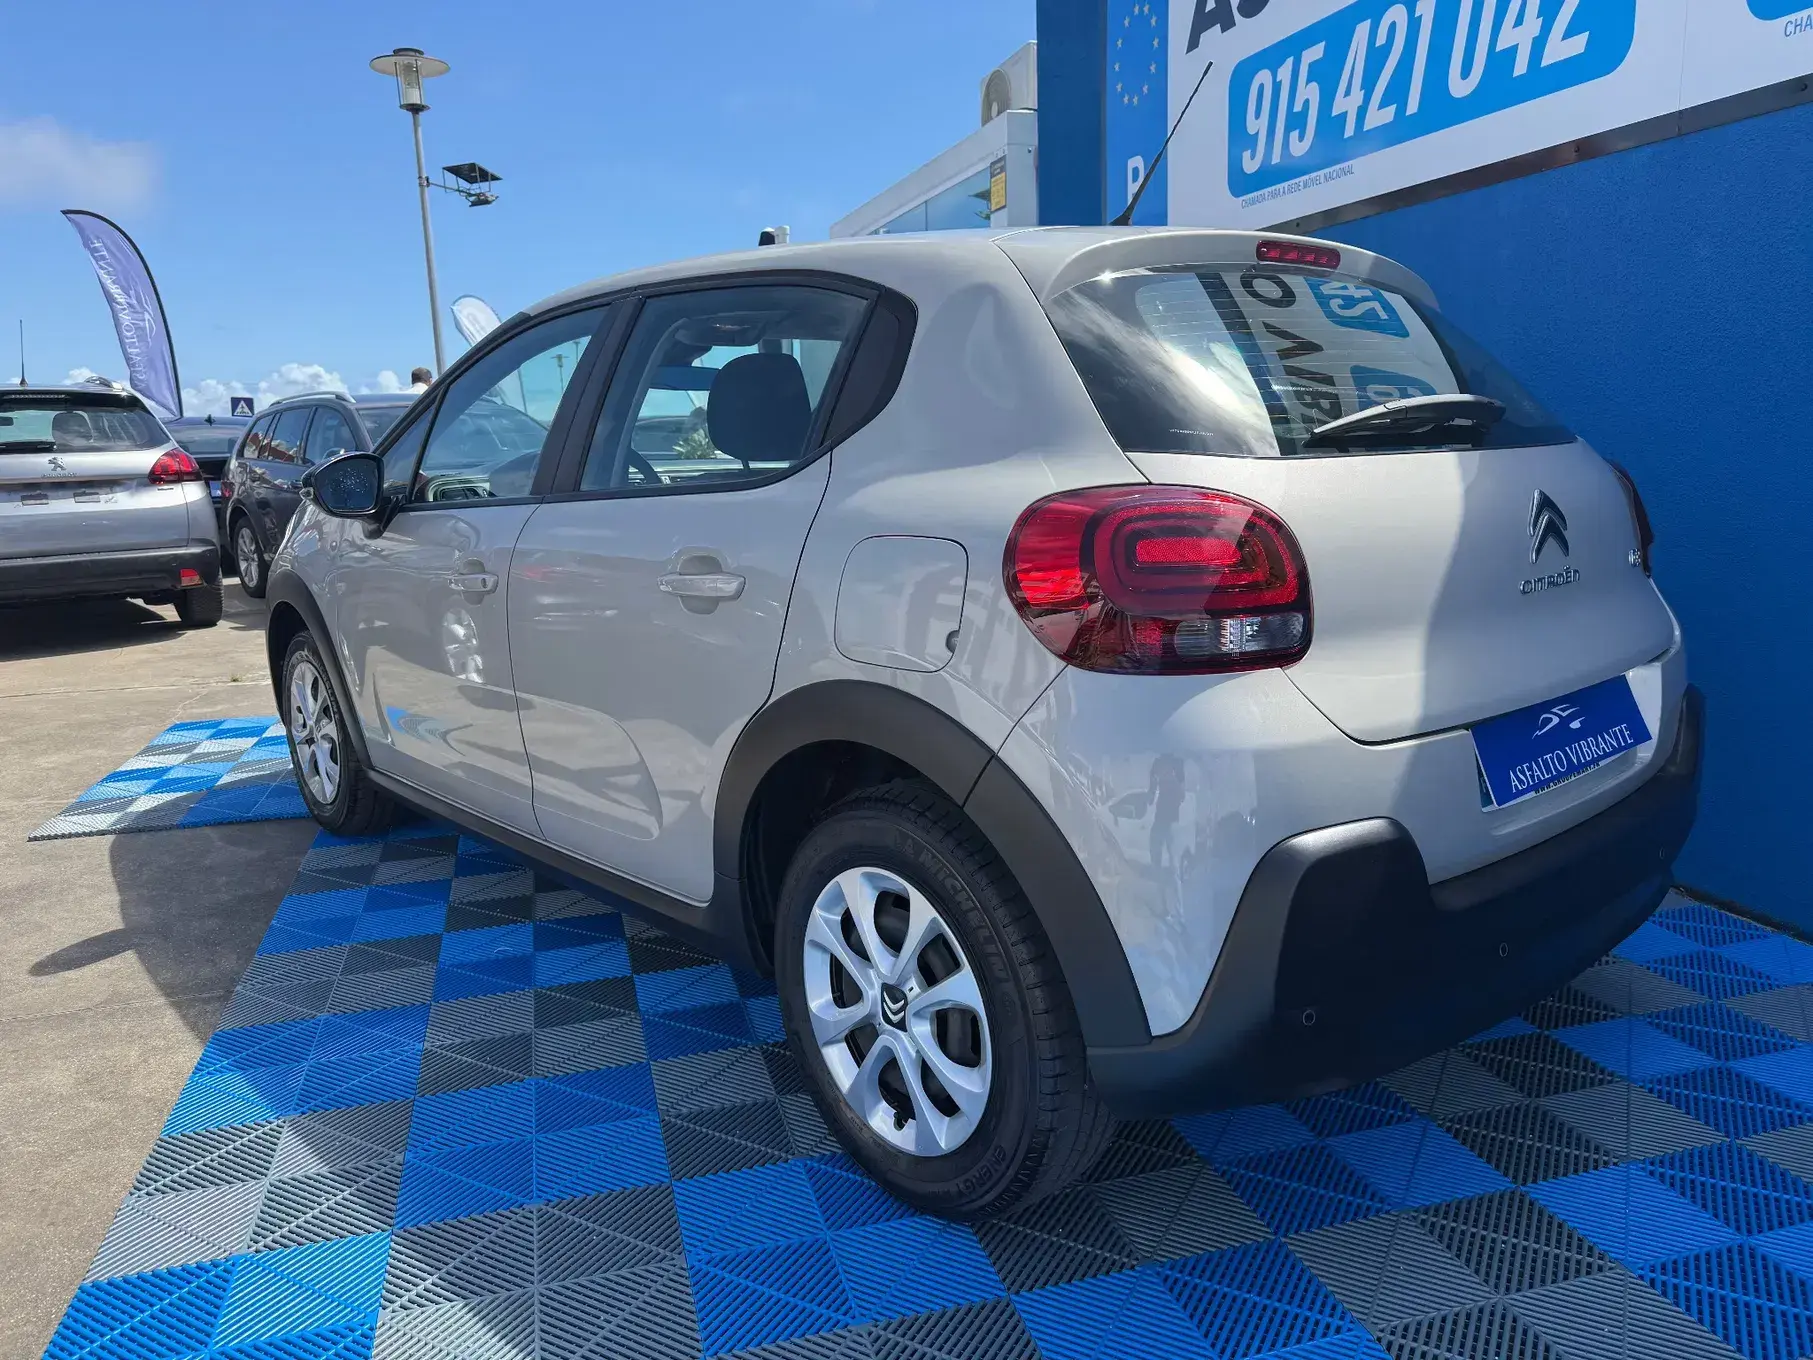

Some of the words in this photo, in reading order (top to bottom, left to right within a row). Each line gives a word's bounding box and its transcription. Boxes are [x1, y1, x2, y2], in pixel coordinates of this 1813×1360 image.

[1242, 41, 1325, 174] 915
[1331, 0, 1435, 139] 421
[1241, 193, 1266, 209] CHAMADA
[1267, 188, 1281, 201] PARA
[1287, 182, 1302, 194] REDE
[1303, 175, 1322, 190] MÓVEL
[1323, 164, 1355, 183] NACIONAL
[1509, 750, 1567, 794] ASFALTO
[1565, 723, 1634, 766] VIBRANTE
